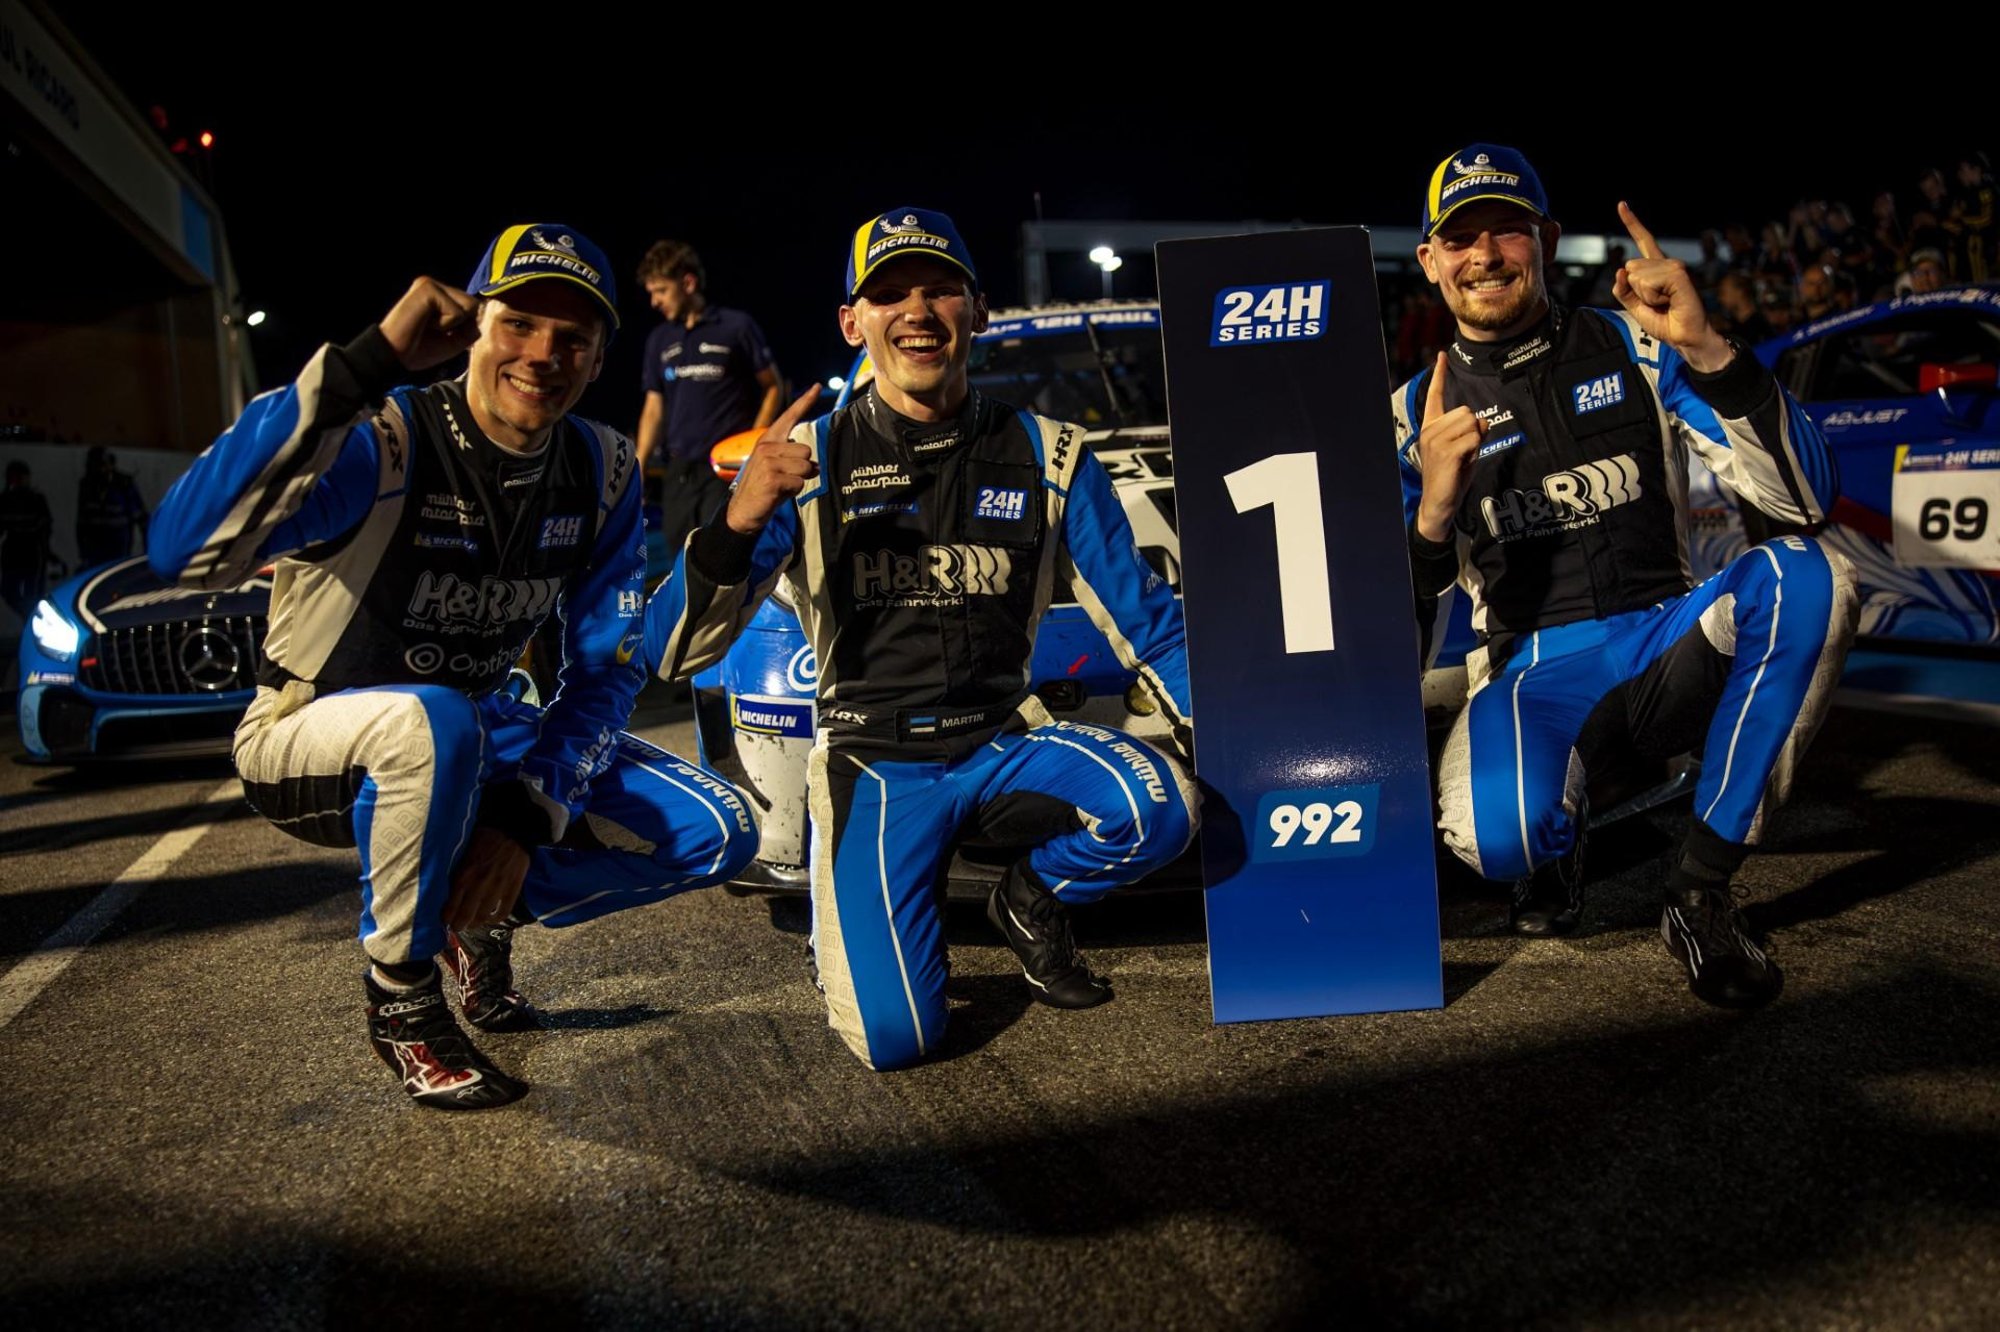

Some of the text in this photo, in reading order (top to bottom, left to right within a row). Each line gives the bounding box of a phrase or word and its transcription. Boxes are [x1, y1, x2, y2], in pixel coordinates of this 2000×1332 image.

[1442, 175, 1520, 200] MICHELIN
[868, 236, 950, 260] MICHELIN
[511, 253, 602, 284] MICHELIN
[1220, 284, 1324, 326] 24H
[1089, 311, 1156, 325] PAUL
[1218, 320, 1320, 342] SERIES
[1576, 373, 1621, 404] 24H
[1579, 392, 1623, 413] SERIES
[1052, 426, 1074, 471] HRX
[1480, 434, 1521, 455] ICHELIN
[841, 474, 912, 495] motorsport
[858, 501, 914, 516] MICHELIN
[978, 489, 1024, 510] 24H
[1480, 470, 1598, 539] H&R
[978, 508, 1021, 520] SERIES
[1920, 498, 1988, 541] 69
[543, 516, 583, 538] 24H
[539, 536, 578, 548] SERIES
[1223, 451, 1335, 654] 1
[853, 545, 964, 597] H&R
[408, 568, 516, 627] H&R
[402, 617, 436, 632] Das
[741, 707, 797, 728] MICHELIN
[942, 712, 985, 729] MARTIN
[1108, 741, 1168, 803] mühlner
[666, 762, 751, 833] mühlner
[1269, 800, 1363, 849] 992
